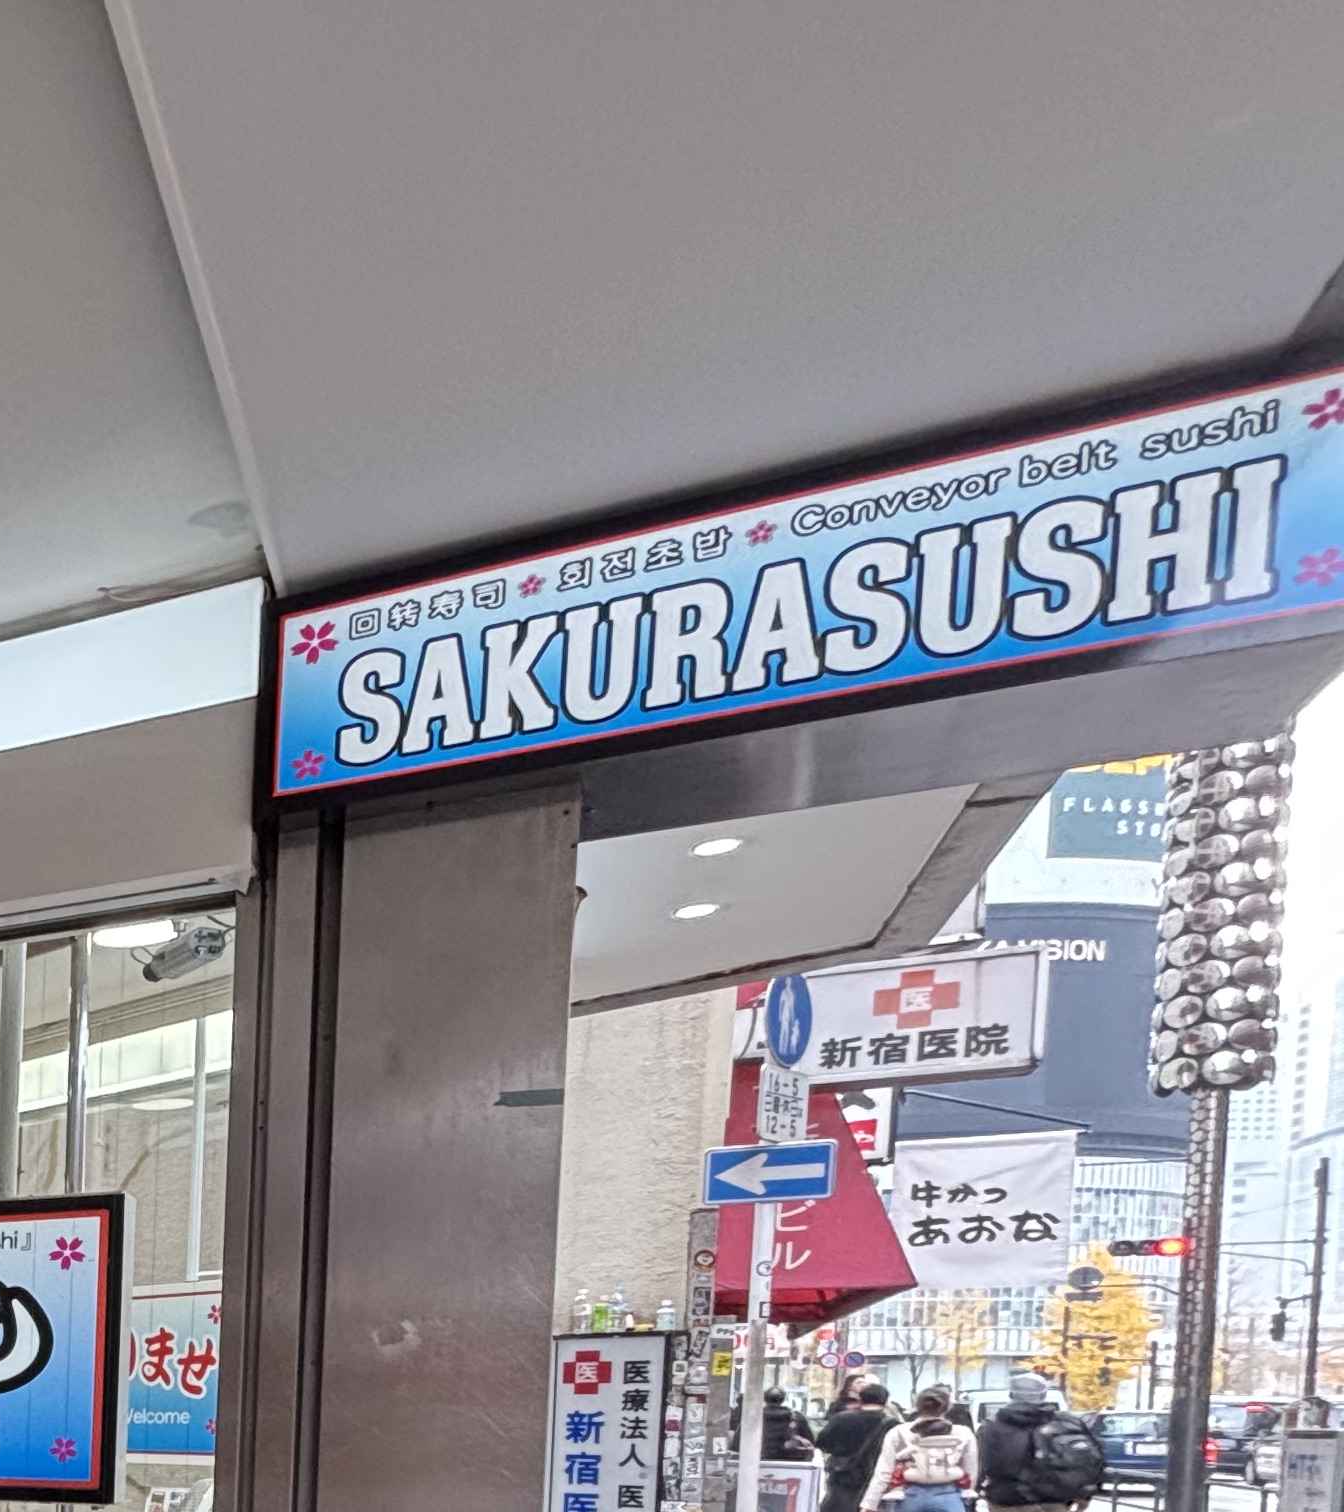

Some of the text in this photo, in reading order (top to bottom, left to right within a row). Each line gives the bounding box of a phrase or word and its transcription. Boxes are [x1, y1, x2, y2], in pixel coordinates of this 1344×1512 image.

[790, 399, 1281, 537] Conveyor belt sushi
[556, 526, 732, 592] 회전초밥
[334, 456, 1288, 767] SAKURASUSHI
[349, 579, 507, 641] 回转寿司
[903, 987, 934, 1013] 医
[819, 1023, 1010, 1070] 新宿医院
[911, 1180, 1008, 1208] 牛かつ
[908, 1210, 1062, 1247] あおな
[575, 1361, 599, 1383] 医
[618, 1360, 651, 1468] 医療法人
